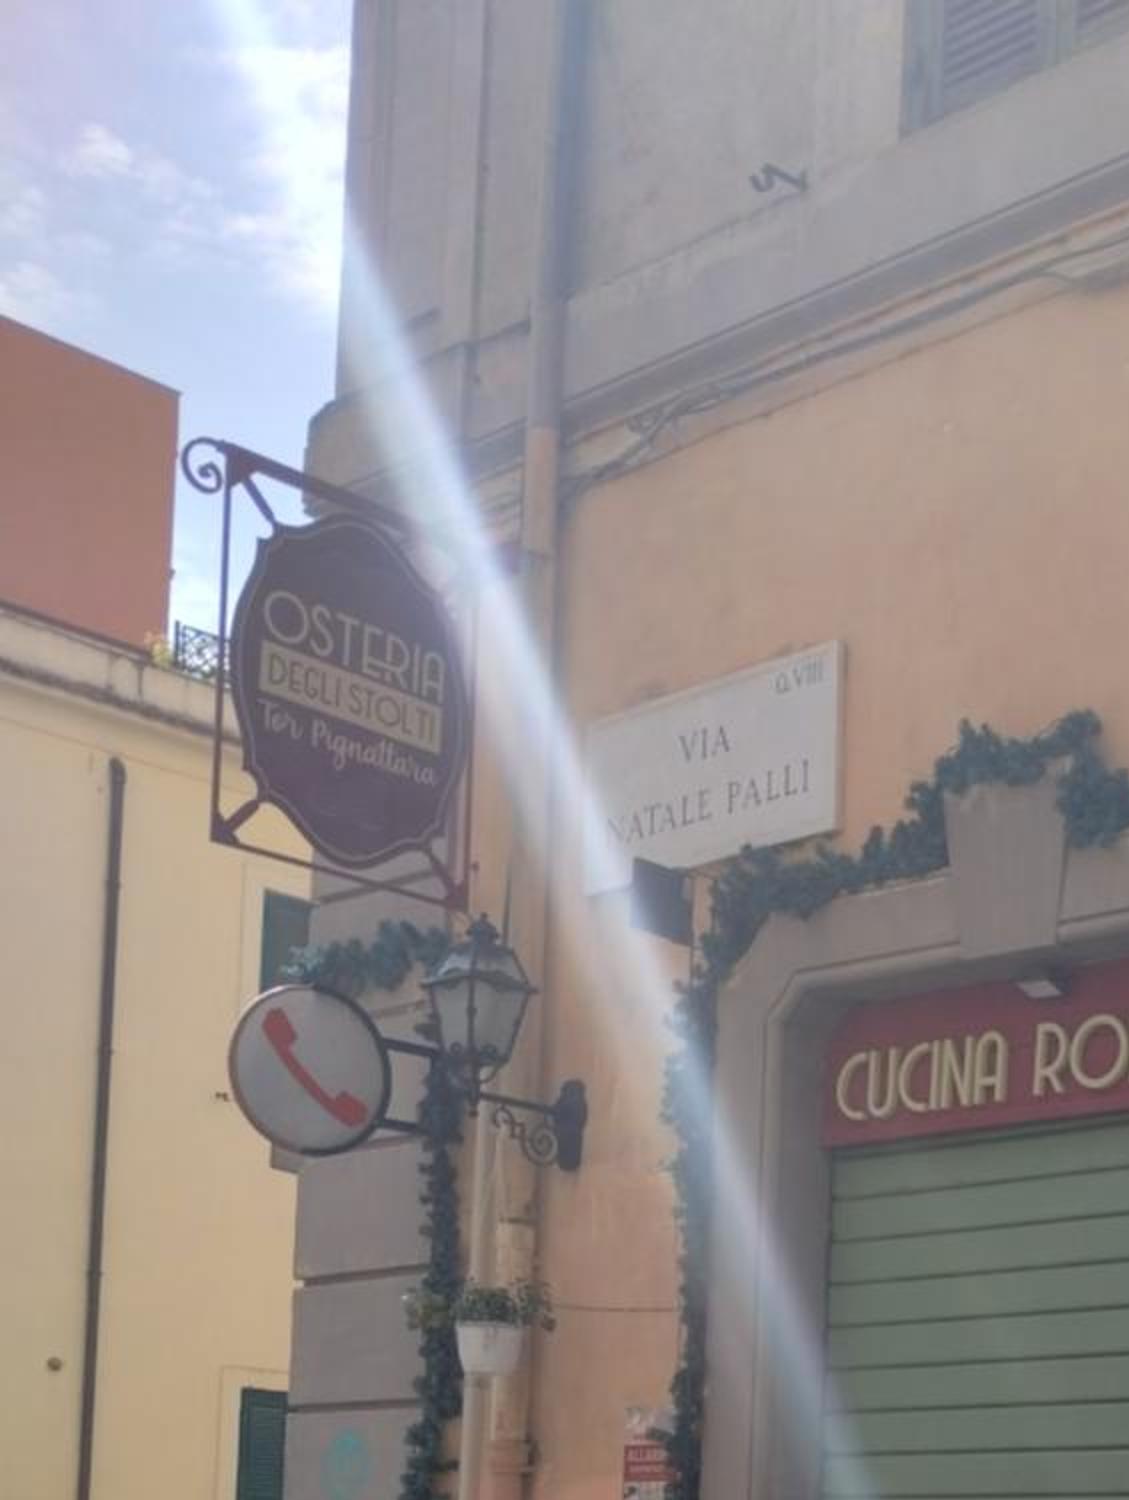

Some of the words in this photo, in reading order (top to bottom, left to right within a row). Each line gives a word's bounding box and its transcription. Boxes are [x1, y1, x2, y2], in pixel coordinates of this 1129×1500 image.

[263, 590, 446, 705] OSTERIA
[256, 697, 304, 741] Tor
[311, 718, 437, 787] Pignattara
[268, 653, 341, 708] DEGLI
[349, 684, 435, 743] STOLTI
[678, 725, 730, 762] VIA
[727, 759, 810, 814] PALLI
[836, 1030, 1009, 1121] CUCINA
